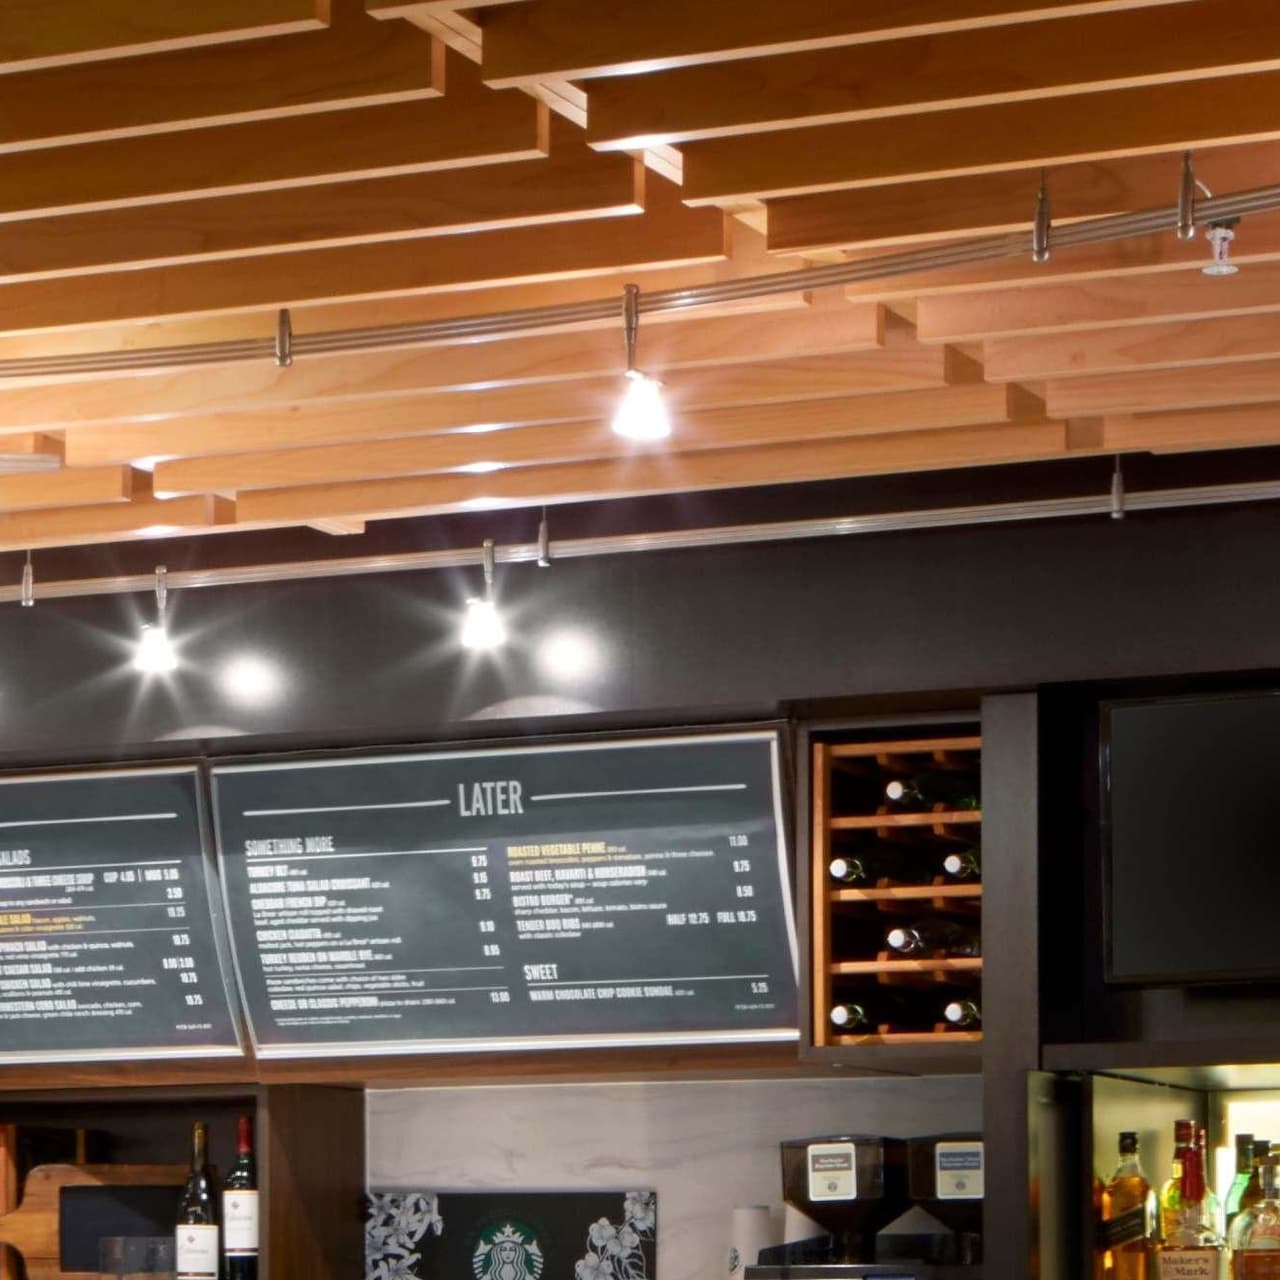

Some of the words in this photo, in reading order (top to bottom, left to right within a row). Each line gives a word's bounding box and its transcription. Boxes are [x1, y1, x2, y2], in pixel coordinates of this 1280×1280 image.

[457, 779, 523, 818] LATER
[245, 837, 303, 856] SOMETHING
[305, 836, 336, 853] MORE
[717, 912, 736, 924] FULL
[524, 964, 558, 981] SWEET
